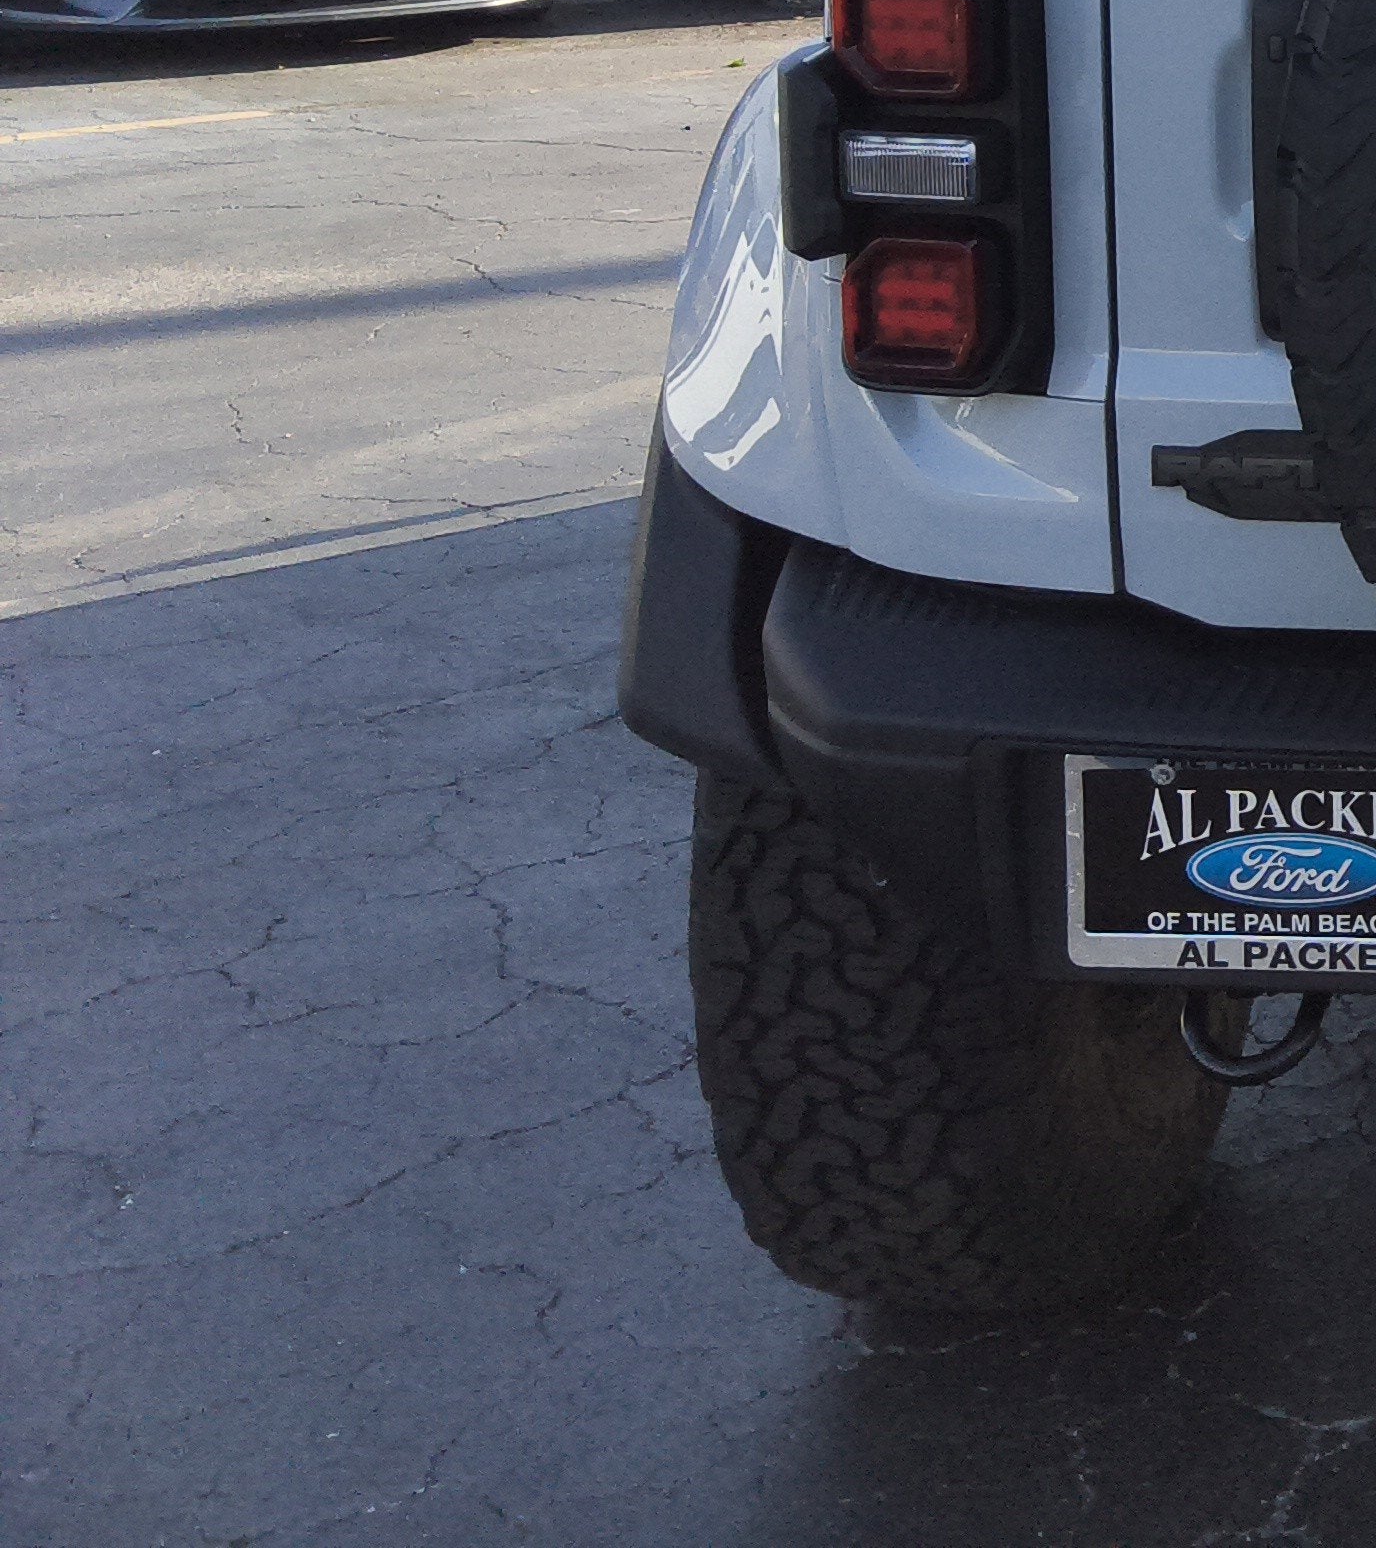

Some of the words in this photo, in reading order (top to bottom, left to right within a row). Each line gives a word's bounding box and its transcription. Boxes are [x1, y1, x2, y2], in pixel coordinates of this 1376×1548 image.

[1139, 788, 1214, 861] AL
[1229, 843, 1354, 895] Ford
[1147, 912, 1180, 931] OF
[1187, 912, 1236, 932] THE
[1243, 913, 1310, 933] PALM
[1177, 941, 1231, 968] AL
